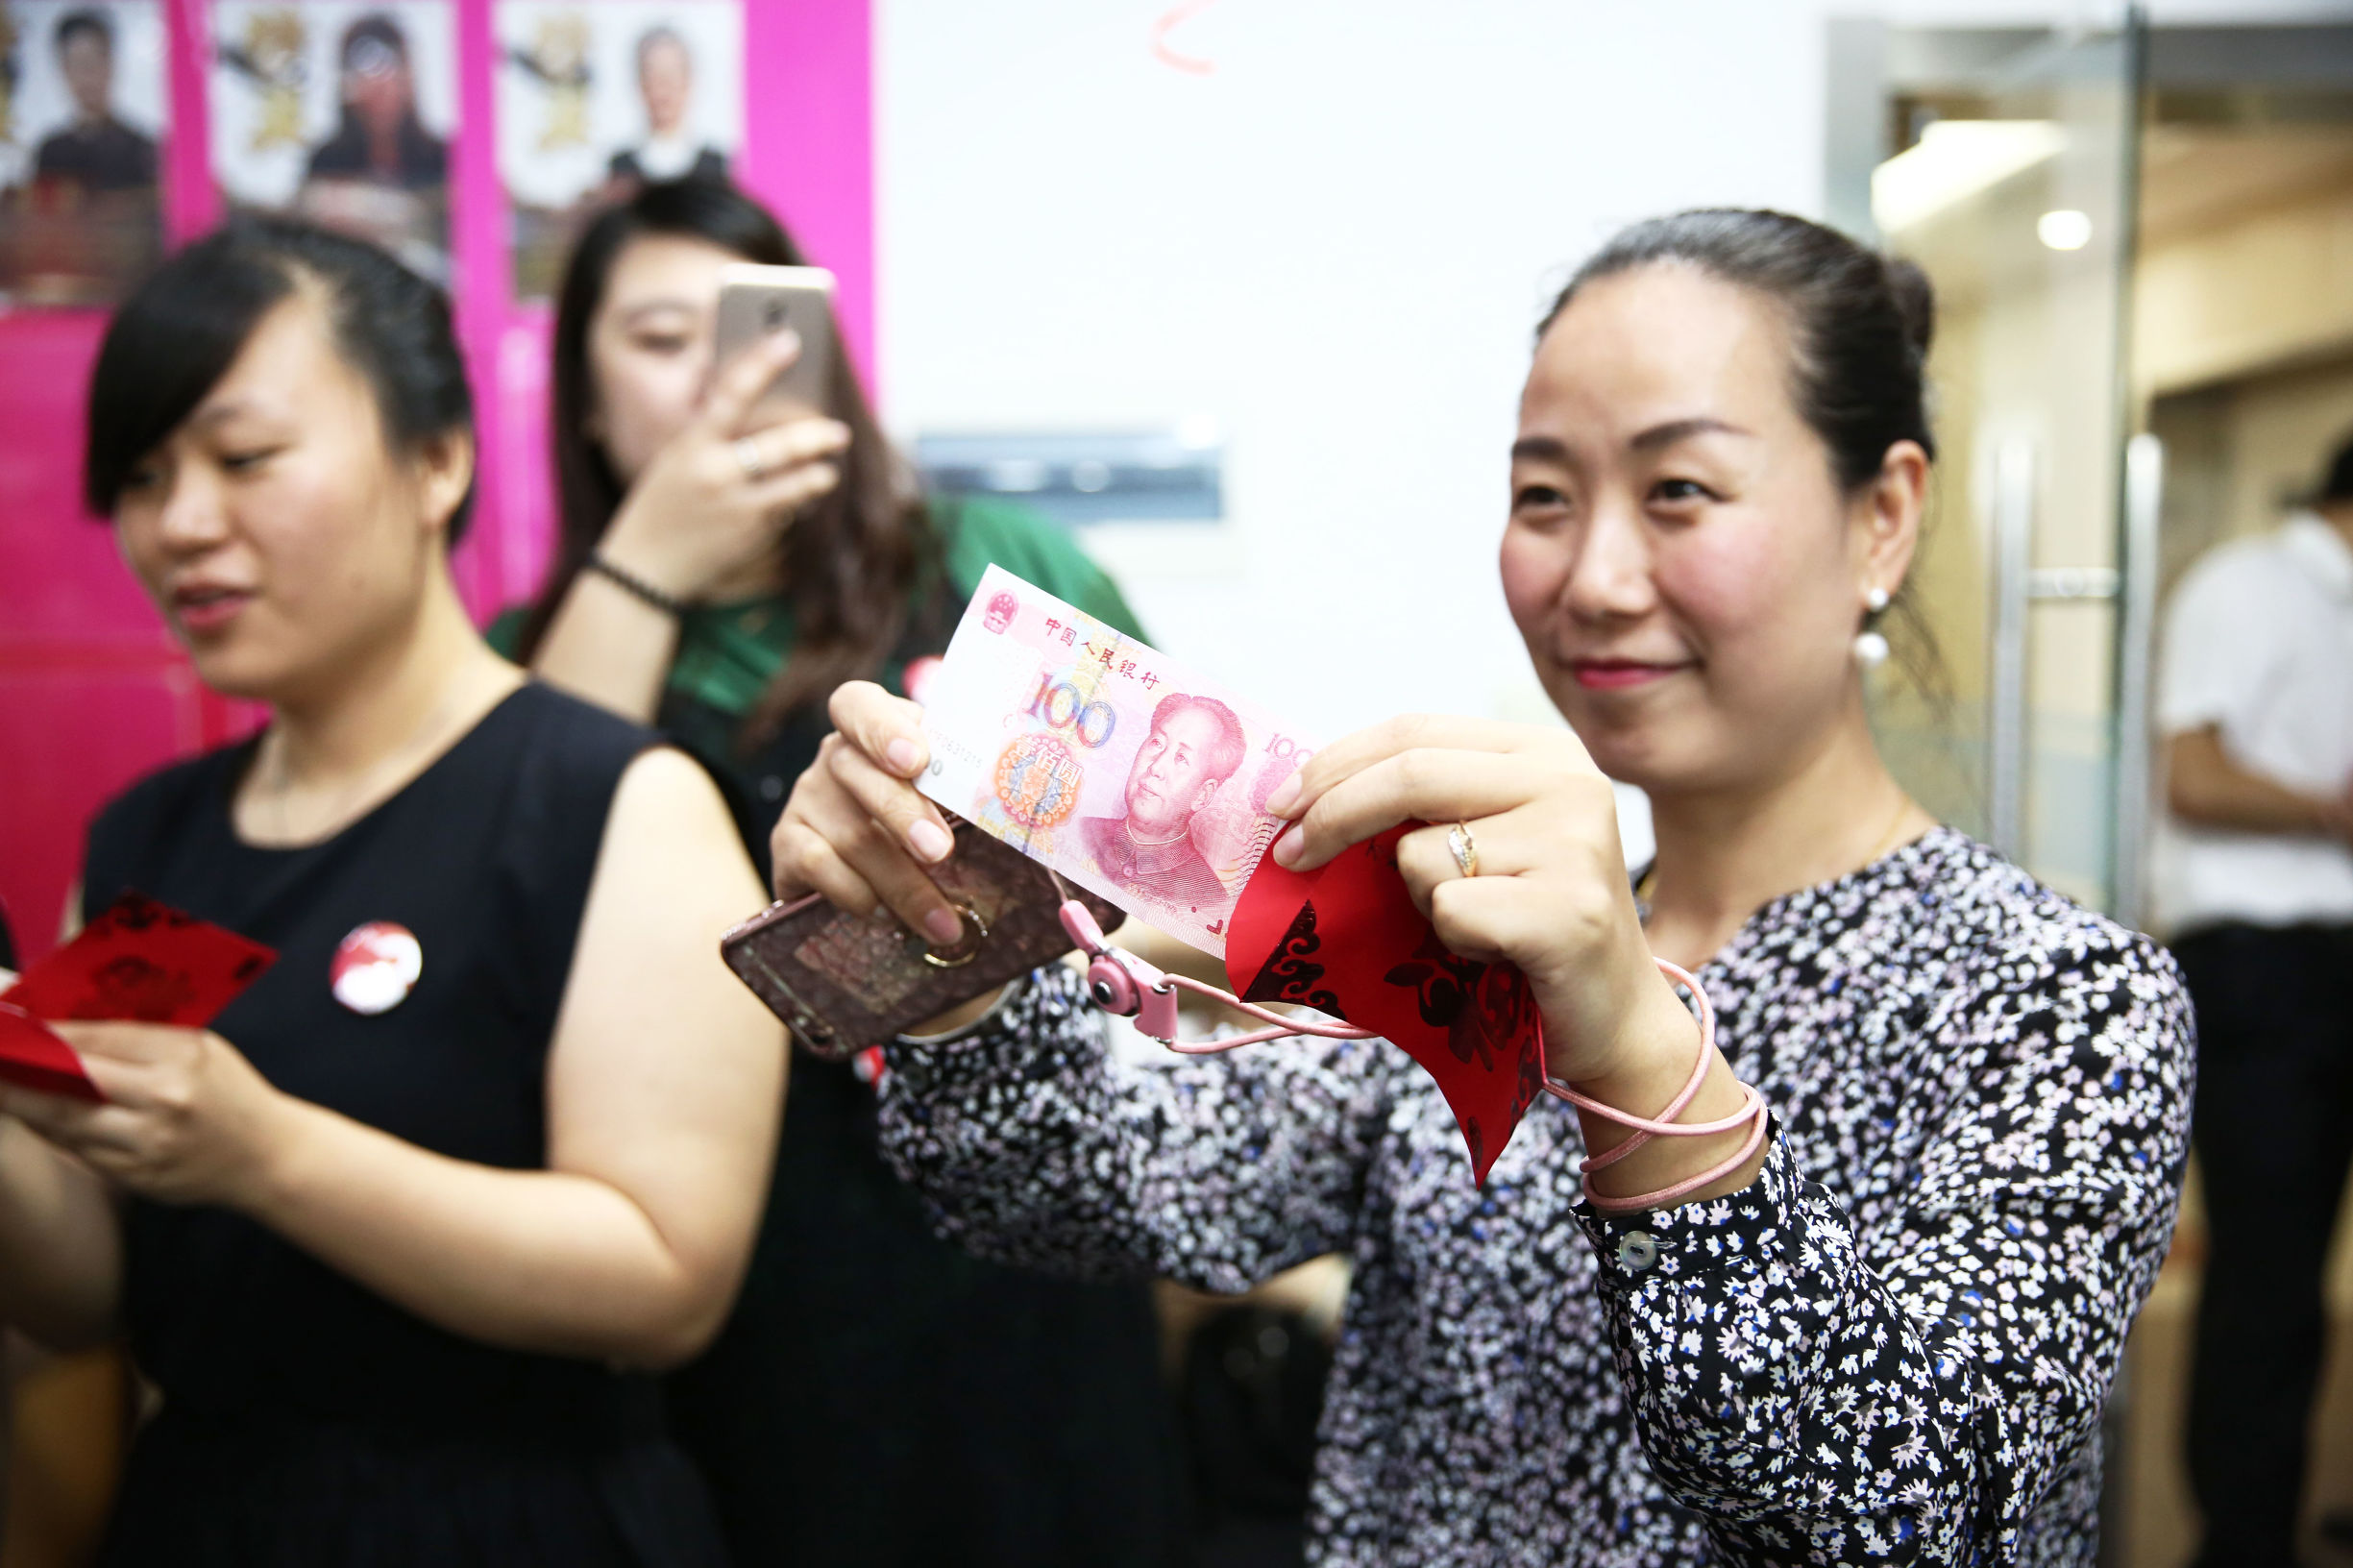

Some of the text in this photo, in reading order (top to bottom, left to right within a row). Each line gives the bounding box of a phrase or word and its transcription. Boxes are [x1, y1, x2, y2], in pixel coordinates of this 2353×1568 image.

[1045, 618, 1160, 690] 中国人民银行
[1023, 672, 1115, 748] 100
[1012, 734, 1084, 788] 壹佰圆
